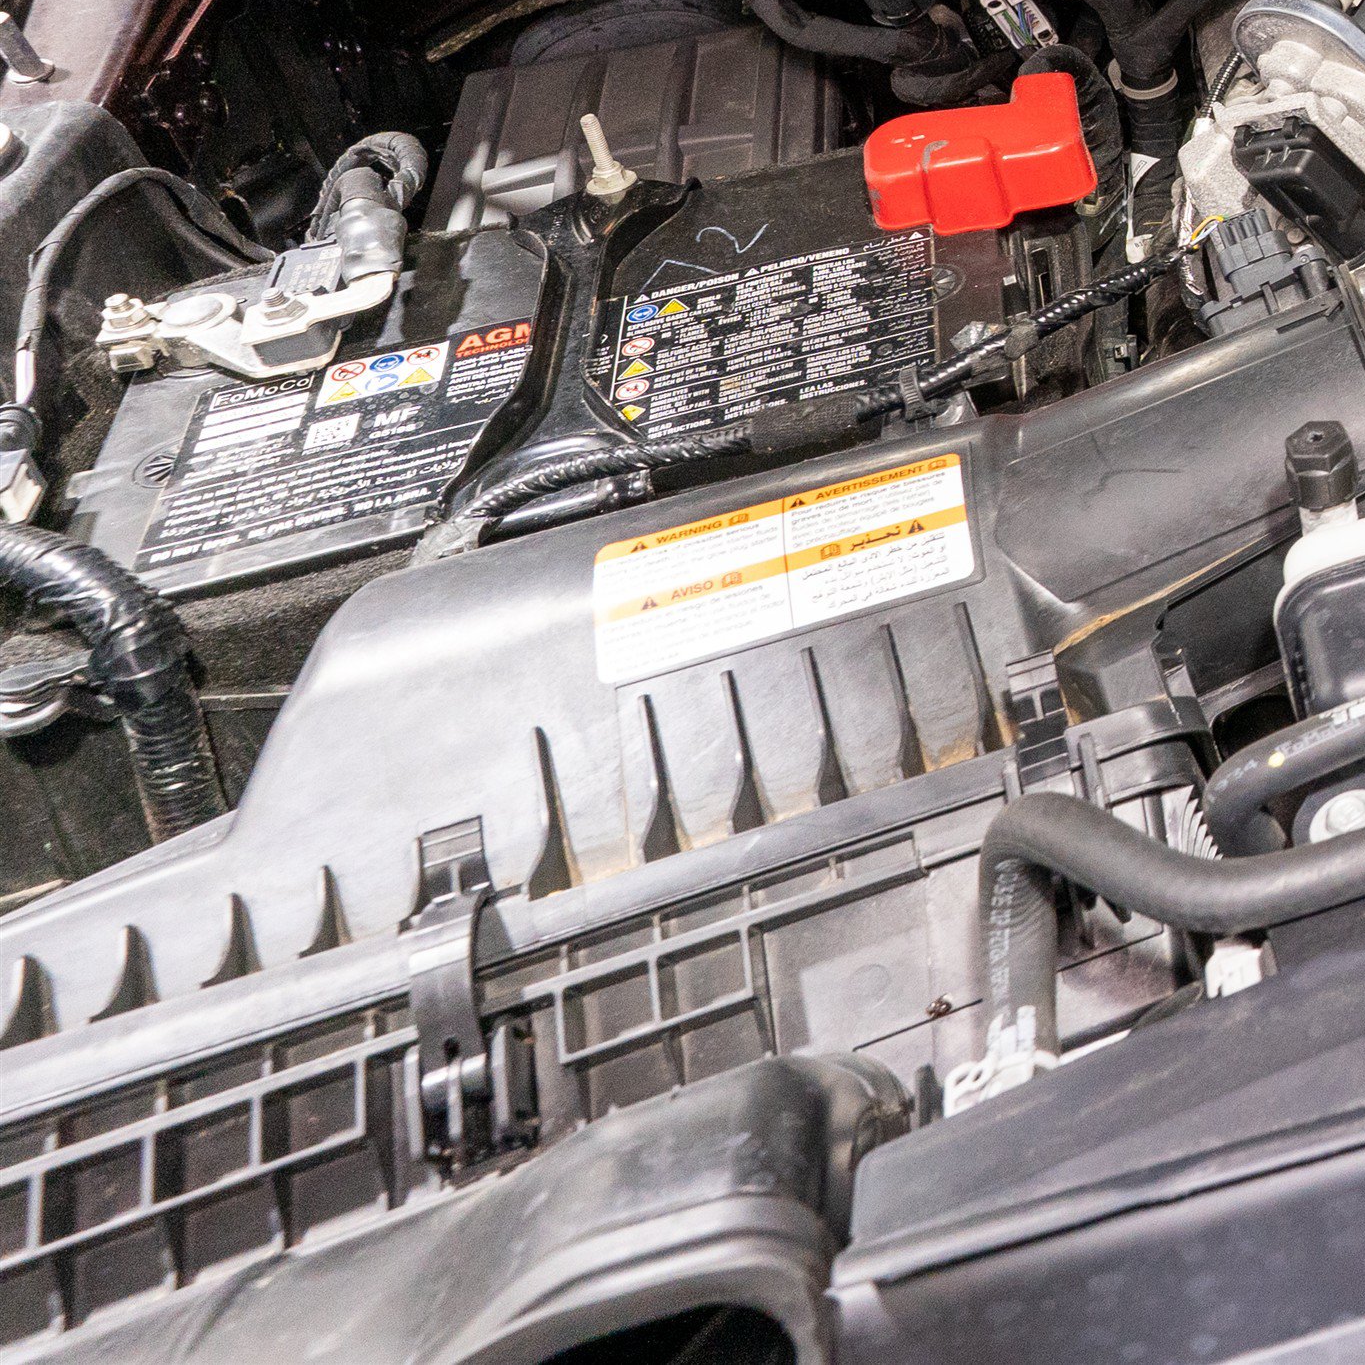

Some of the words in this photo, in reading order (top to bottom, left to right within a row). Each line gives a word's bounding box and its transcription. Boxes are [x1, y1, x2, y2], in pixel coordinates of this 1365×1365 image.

[651, 273, 739, 299] DANGER/POISON
[761, 247, 848, 273] PELIGRO/VENENO
[628, 318, 664, 331] EXPLOSIVE
[666, 312, 687, 322] GASES
[627, 325, 660, 337] BLINDNESS
[657, 347, 690, 359] SULFURIC
[691, 343, 706, 351] ACID
[656, 356, 675, 365] CAUSE
[214, 372, 311, 408] FoMoCo
[654, 380, 675, 389] REACH
[800, 386, 815, 394] LEA
[818, 382, 833, 390] LAS
[651, 392, 671, 401] FLUSH
[673, 388, 688, 396] EYES
[649, 409, 676, 420] MEDICAL
[678, 404, 693, 412] HELP
[725, 405, 743, 413] LIRE
[746, 400, 760, 408] LES
[373, 404, 421, 427] MF
[648, 423, 672, 433] READ
[815, 464, 924, 500] AVERTISSEMENT
[791, 506, 812, 517] Pour
[148, 550, 172, 563] DO
[171, 543, 202, 557] NOT
[353, 500, 373, 512] NO
[374, 495, 392, 507] LA
[656, 520, 722, 545] WARNING
[671, 580, 714, 602] AVISO
